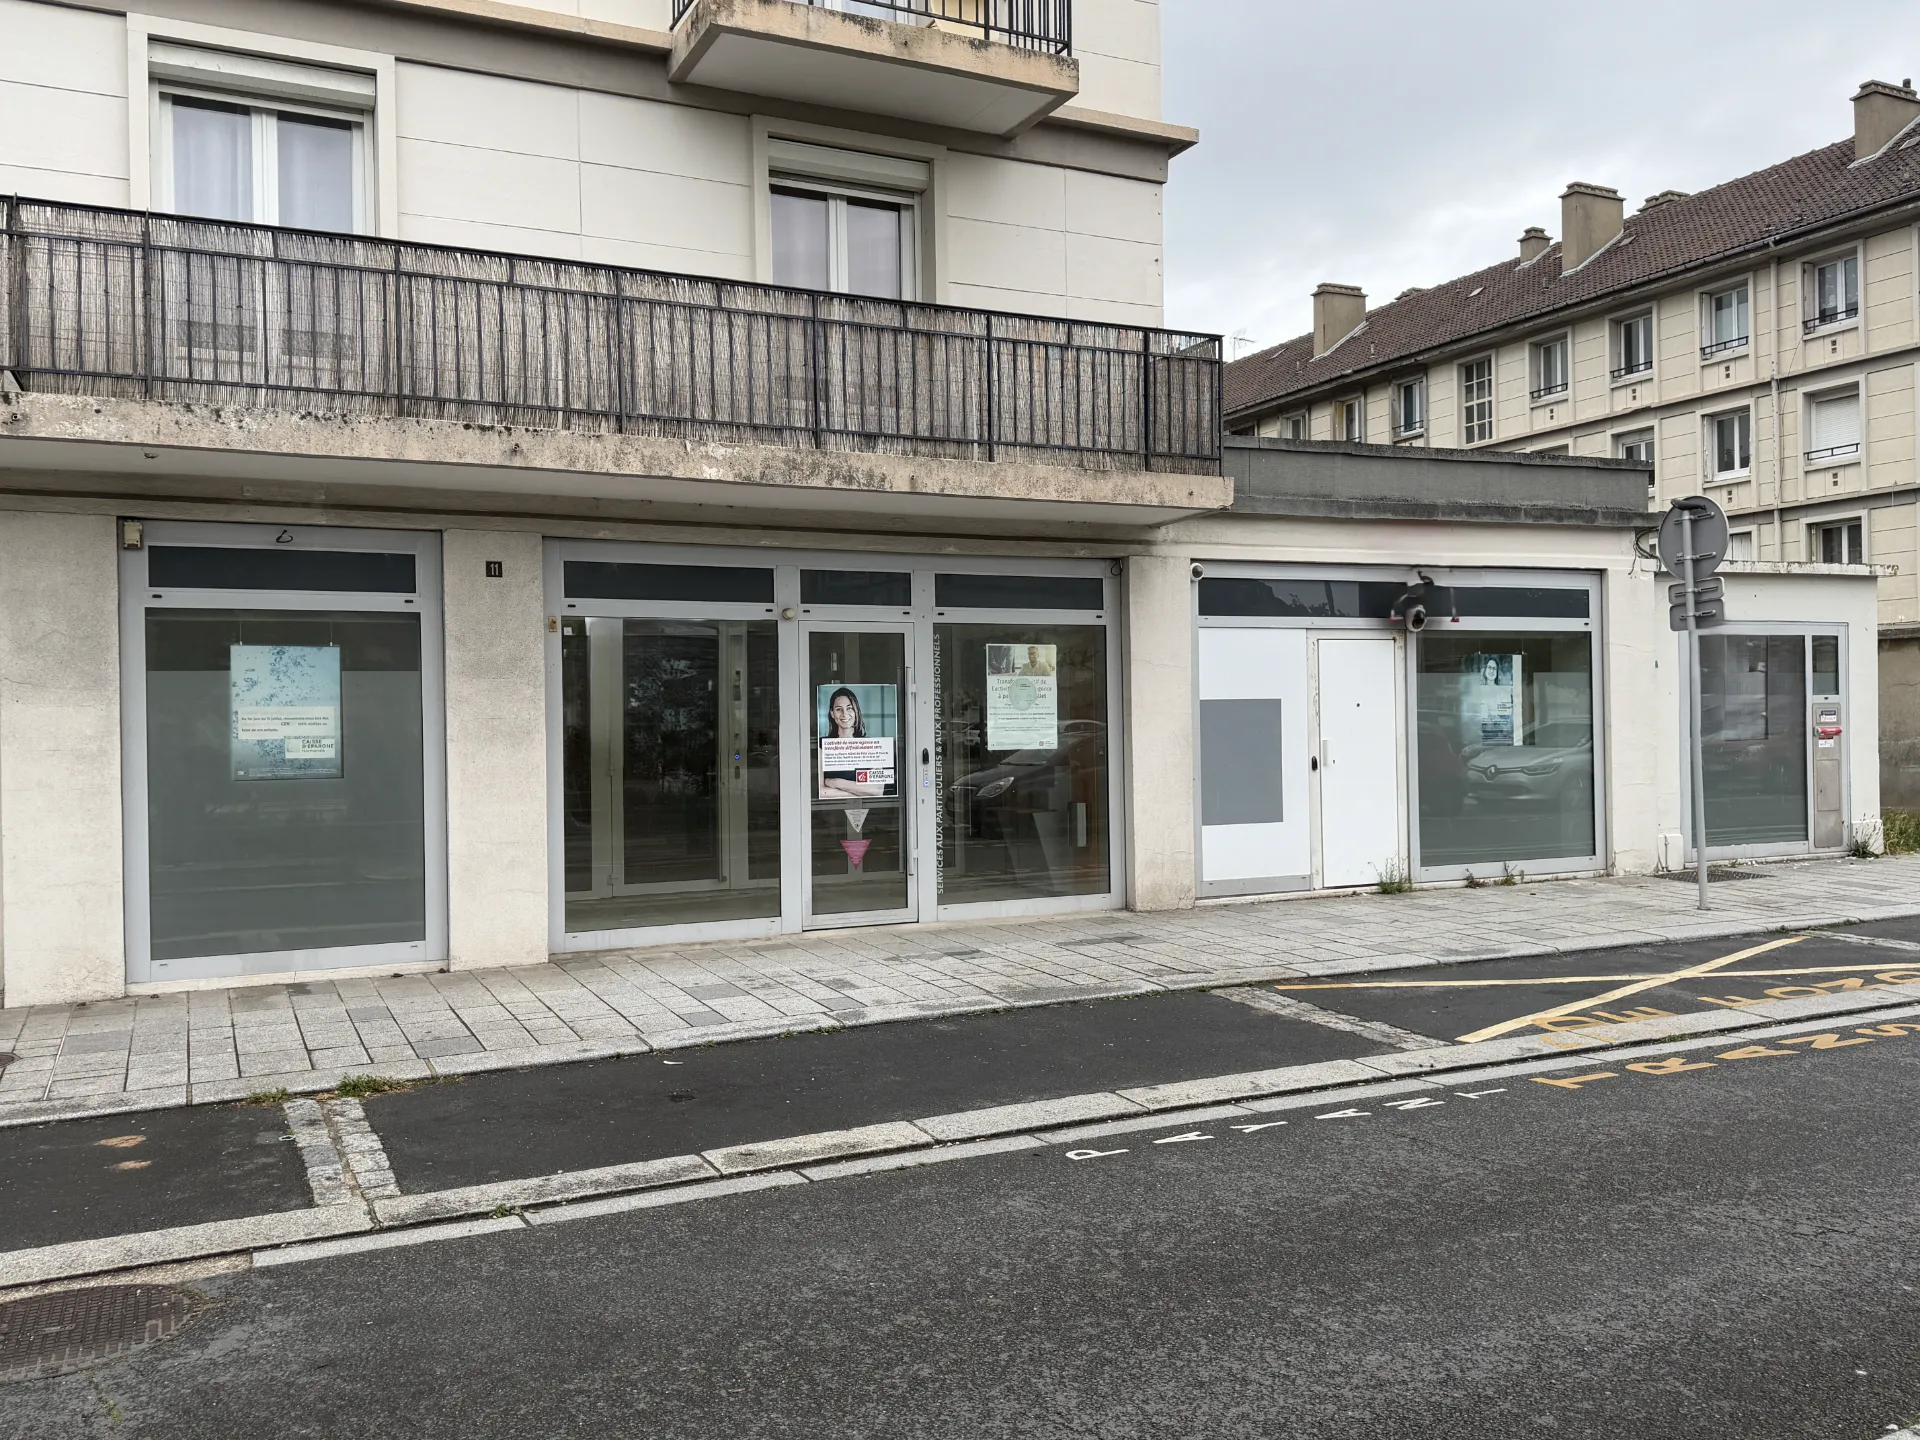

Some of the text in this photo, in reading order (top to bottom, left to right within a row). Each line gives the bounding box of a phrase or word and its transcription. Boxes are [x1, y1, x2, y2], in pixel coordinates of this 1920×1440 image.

[490, 563, 499, 576] 11
[934, 633, 942, 720] PROFESSIONNELS
[935, 721, 943, 744] AUX
[935, 755, 943, 823] PARTICULIERS
[936, 826, 944, 848] AUX
[1065, 1088, 1508, 1161] PAYANT
